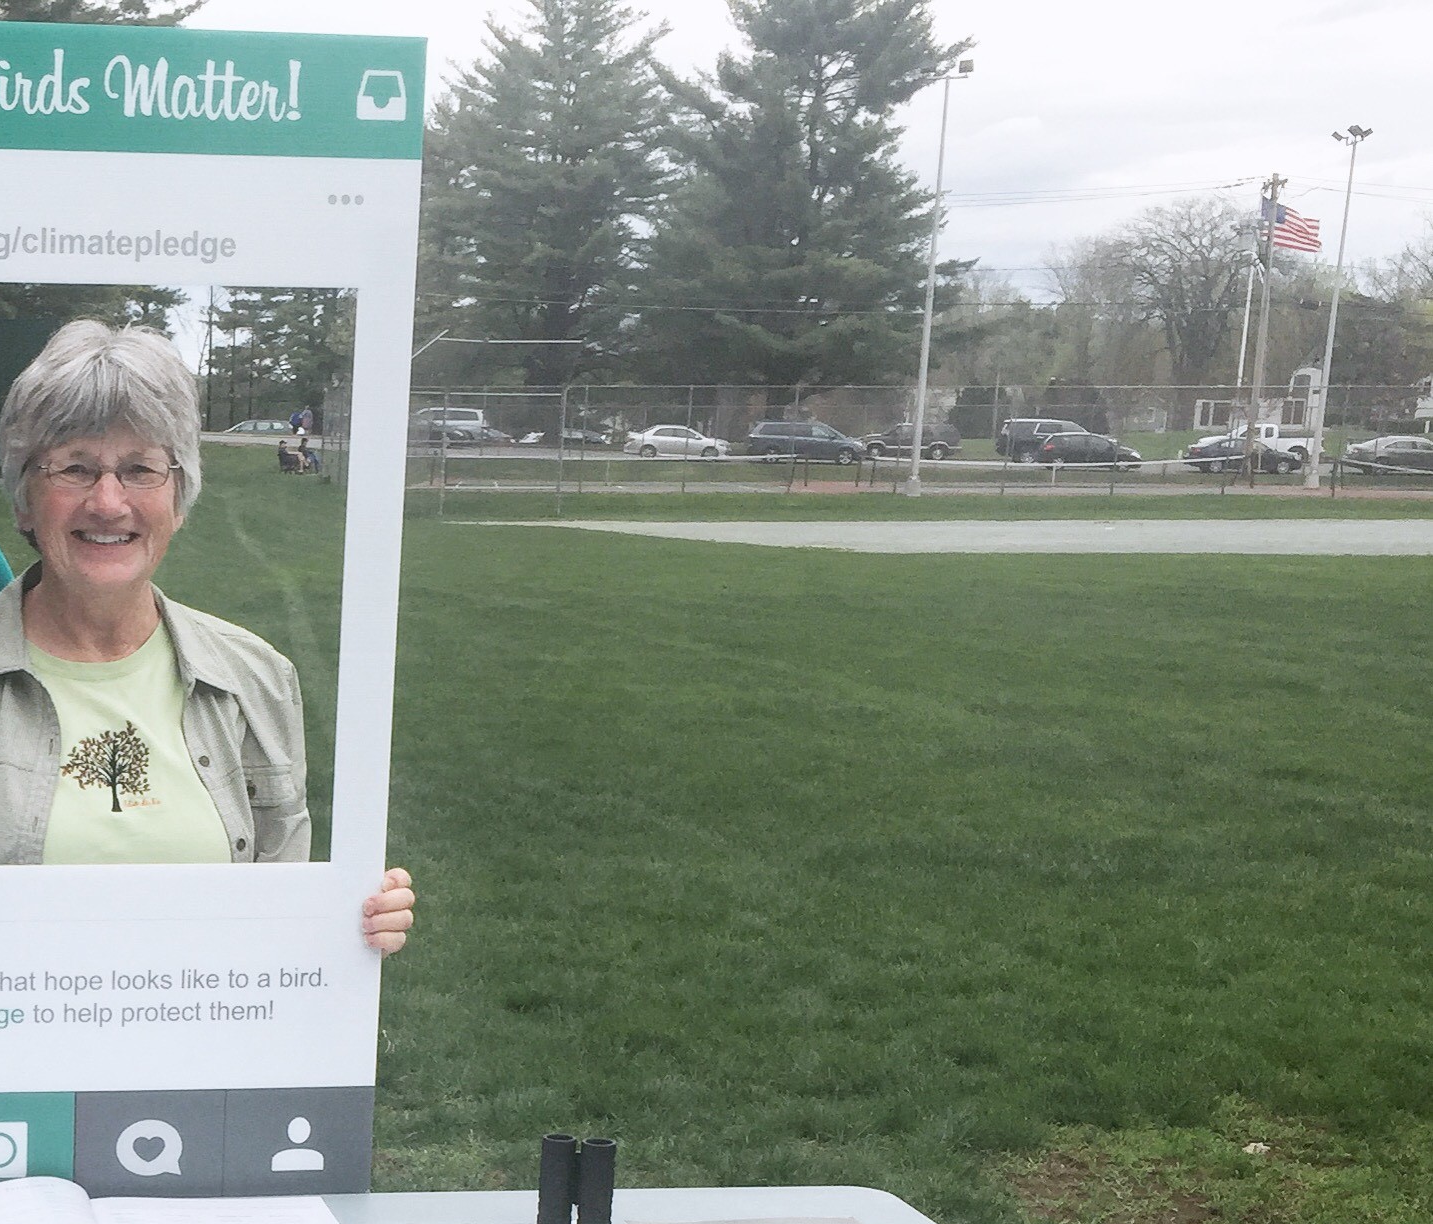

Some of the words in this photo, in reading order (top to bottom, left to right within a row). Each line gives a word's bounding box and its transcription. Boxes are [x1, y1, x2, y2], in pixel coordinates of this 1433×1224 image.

[103, 55, 302, 123] Matter!
[44, 971, 103, 995] hope
[111, 970, 173, 990] looks
[181, 969, 220, 989] like
[228, 971, 249, 989] to
[257, 973, 271, 988] a
[280, 967, 329, 988] bird.
[33, 1005, 55, 1023] to
[64, 1003, 112, 1027] help
[121, 1003, 201, 1026] protect
[209, 1000, 273, 1021] them!
